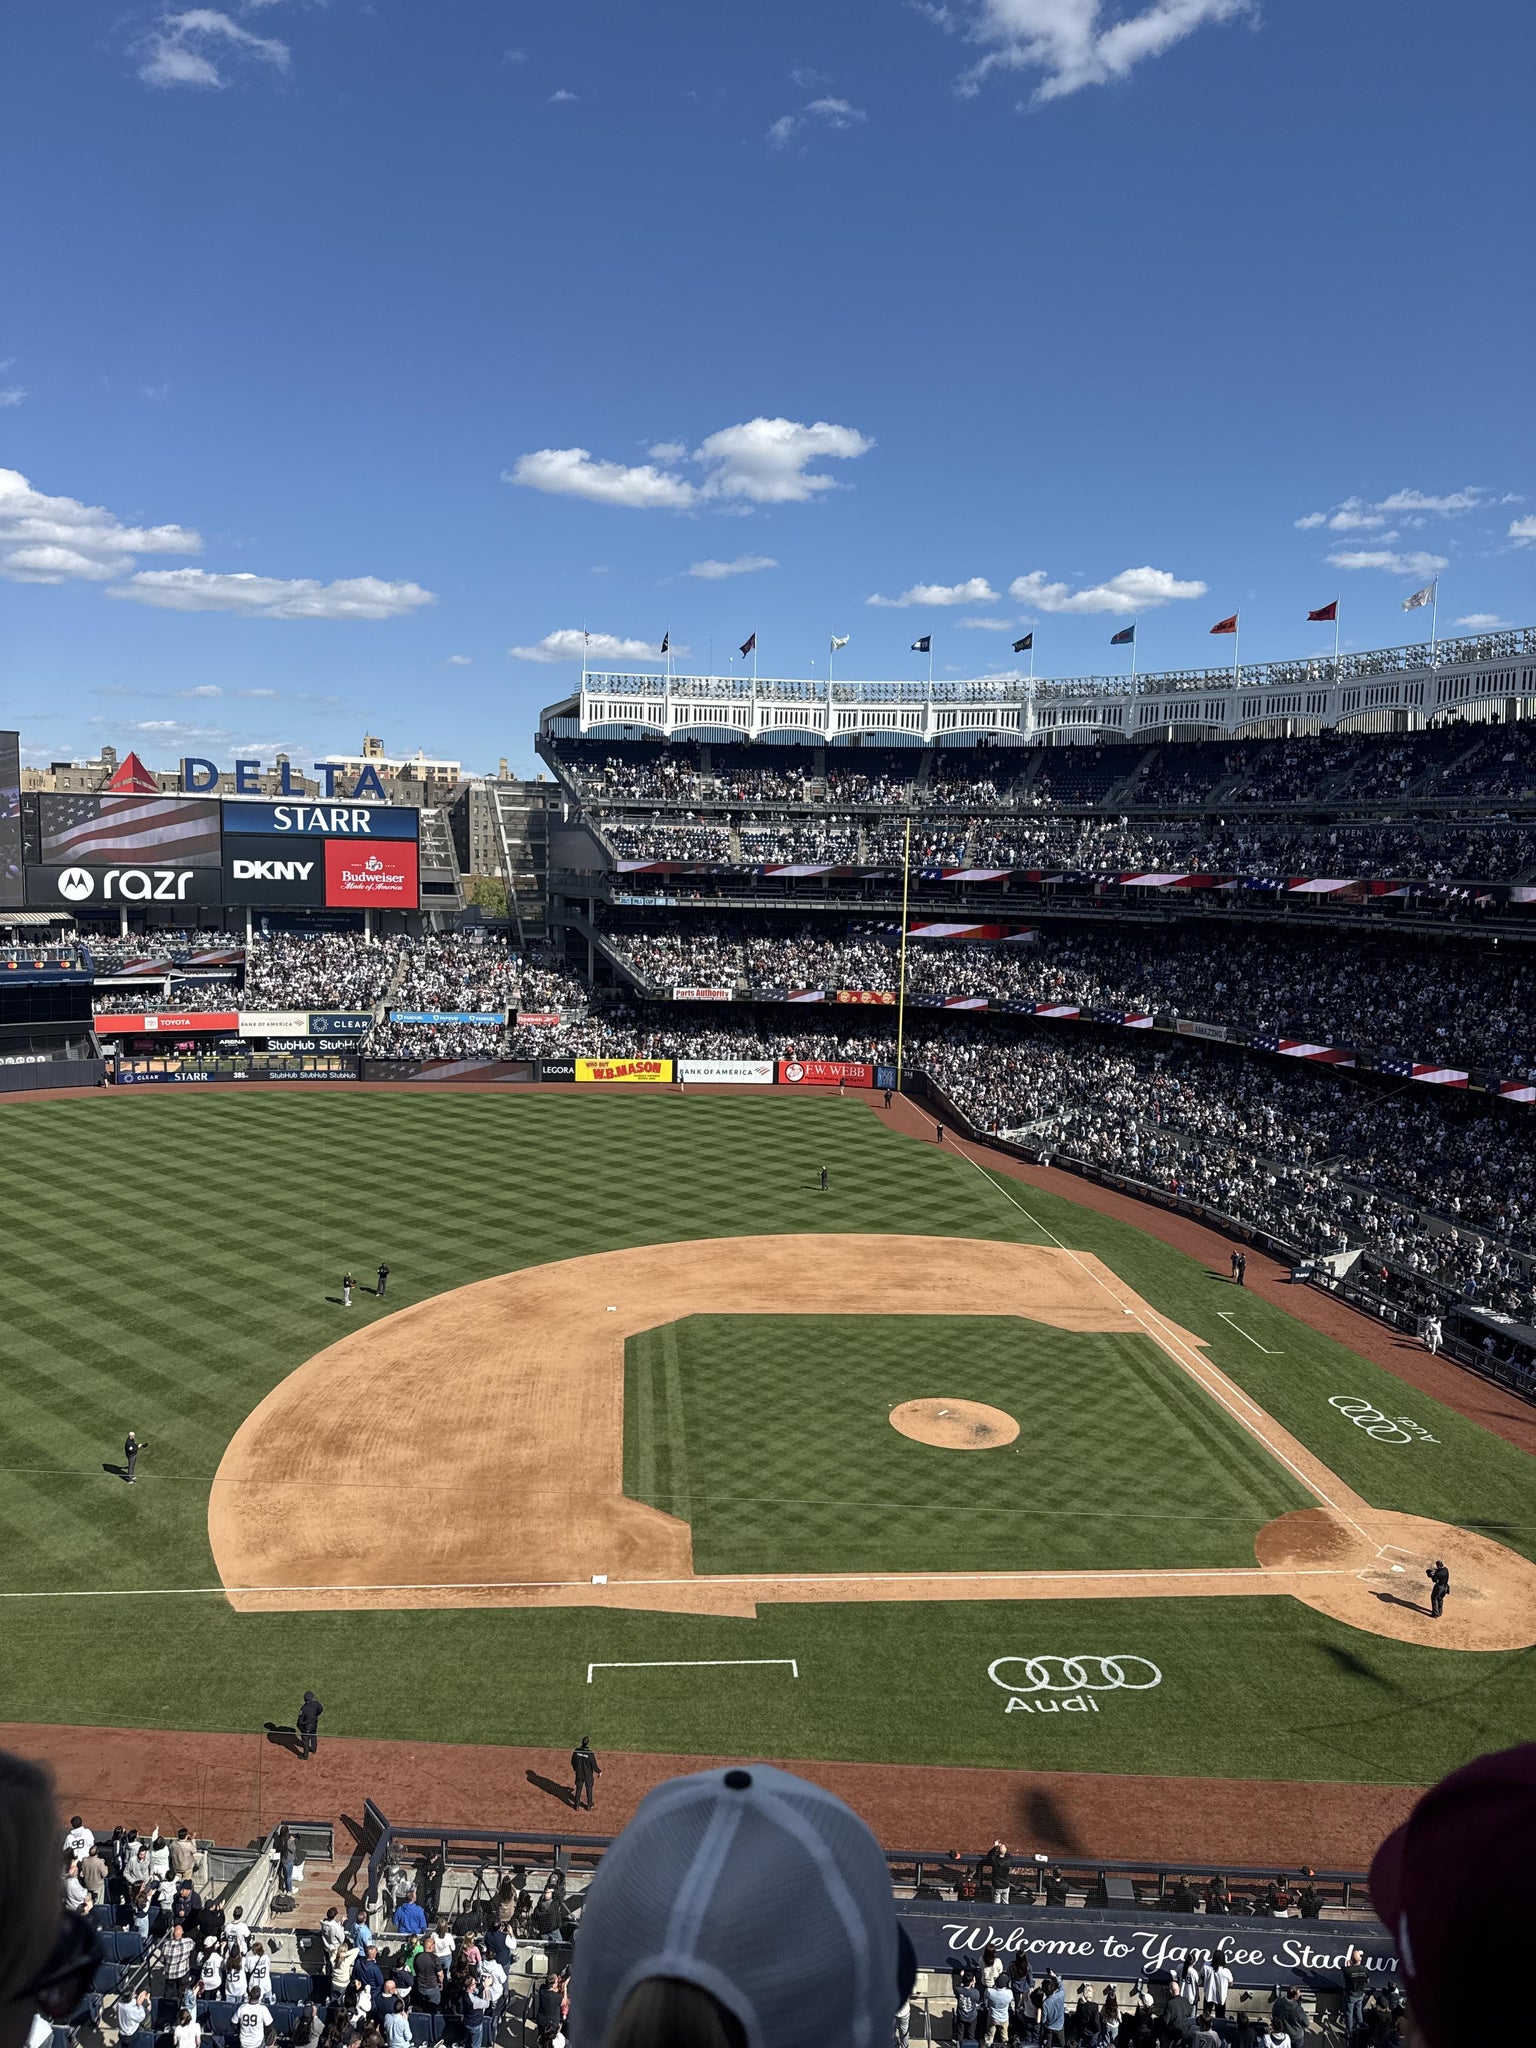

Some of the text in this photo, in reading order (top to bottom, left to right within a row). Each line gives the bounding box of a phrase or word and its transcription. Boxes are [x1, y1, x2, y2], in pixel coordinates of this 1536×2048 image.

[185, 758, 387, 799] DELTA
[273, 805, 372, 833] STARR
[232, 859, 315, 880] DKNY
[341, 870, 405, 883] Budweiser
[103, 869, 194, 900] razr
[676, 989, 729, 998] Parts Authority
[160, 1019, 191, 1027] TOYOTA
[333, 1020, 368, 1028] CLEAR
[267, 1040, 316, 1051] StubHub
[542, 1066, 575, 1074] LEGORA
[679, 1068, 703, 1076] BANK
[805, 1065, 865, 1077] F.W. WEBB
[174, 1072, 208, 1081] STARR
[1392, 1416, 1442, 1444] Audi
[1004, 1694, 1100, 1713] Audi
[71, 1838, 85, 1849] 99
[963, 1887, 976, 1897] 32
[942, 1923, 1095, 1956] Welcome
[1099, 1935, 1136, 1958] to
[242, 2013, 258, 2027] 99
